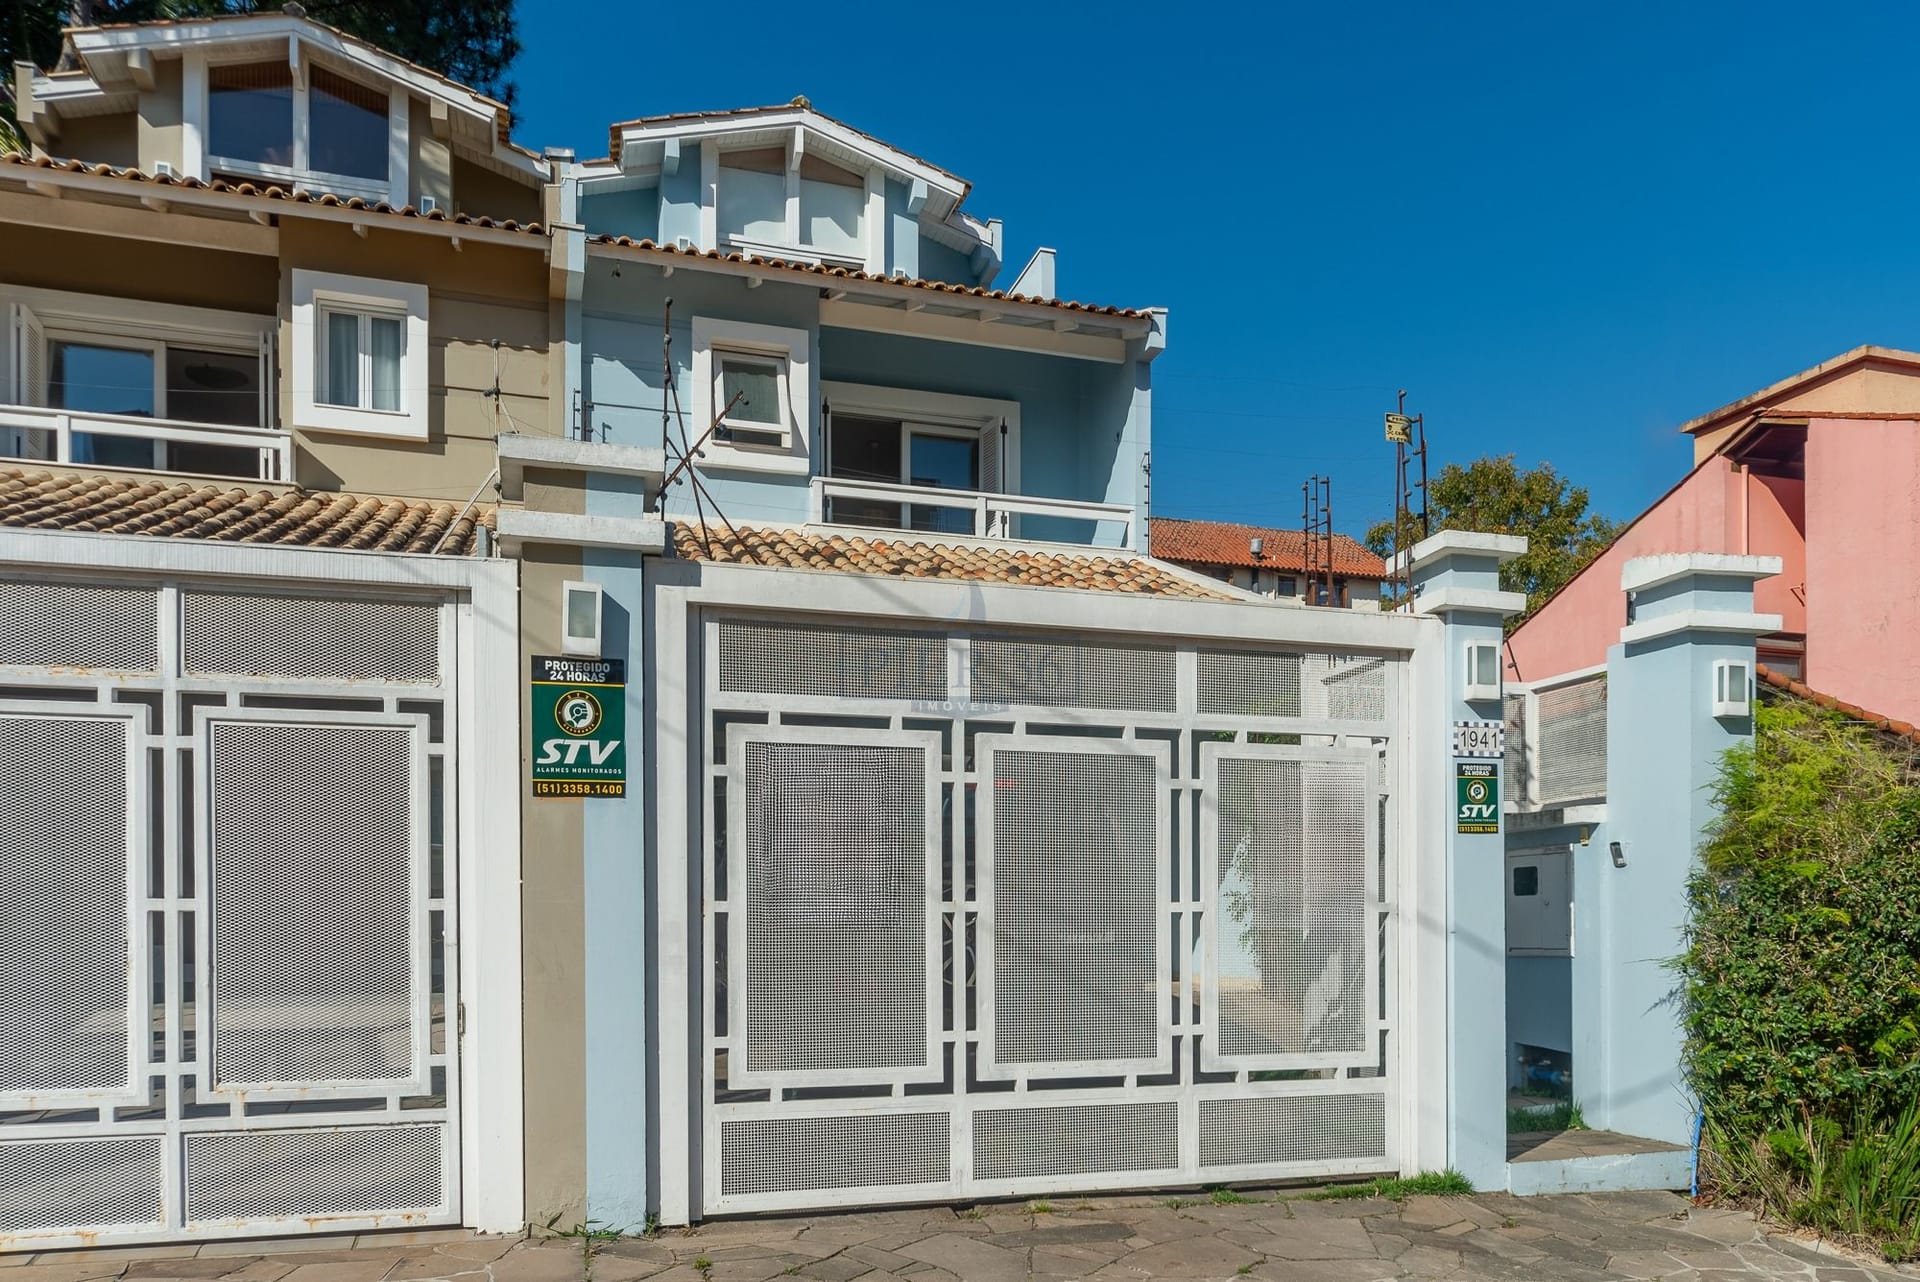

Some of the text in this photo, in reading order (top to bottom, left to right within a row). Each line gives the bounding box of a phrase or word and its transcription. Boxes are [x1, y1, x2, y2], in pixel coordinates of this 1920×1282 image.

[544, 660, 610, 672] PROTEGIDO
[550, 671, 606, 682] 24 HORAS
[1460, 730, 1497, 748] 1941
[536, 738, 621, 765] STV
[572, 767, 622, 775] MONITORADOS
[1458, 804, 1497, 818] STV
